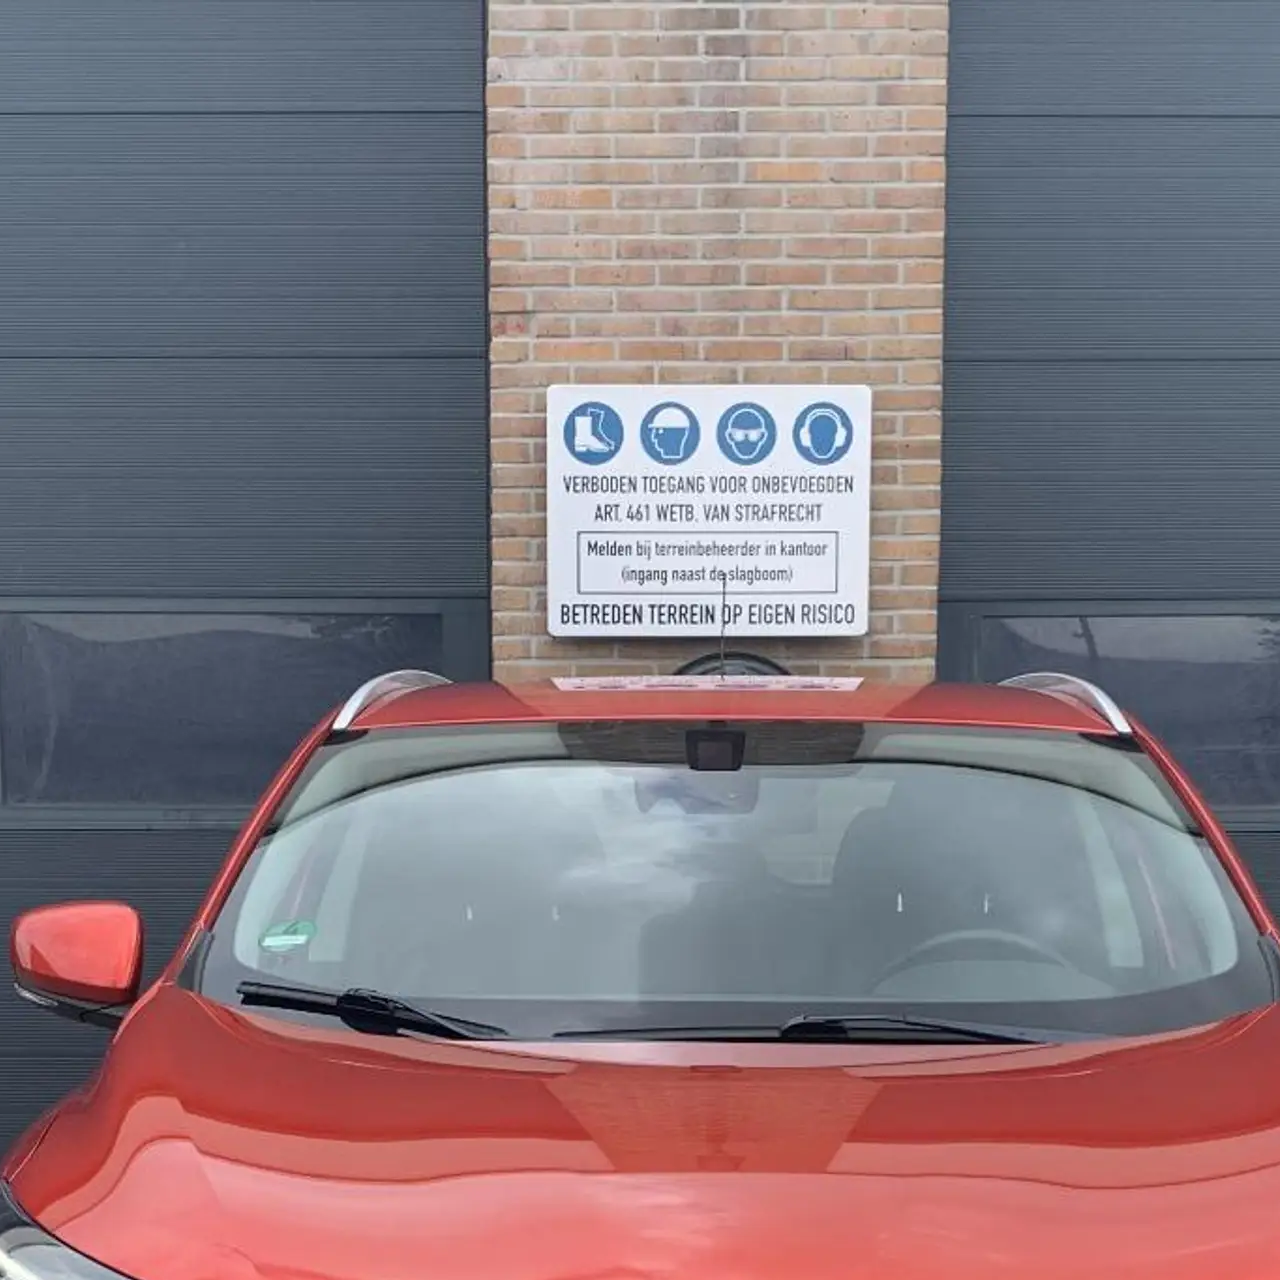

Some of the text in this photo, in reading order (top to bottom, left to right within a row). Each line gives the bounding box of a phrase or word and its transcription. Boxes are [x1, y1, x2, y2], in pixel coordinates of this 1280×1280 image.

[563, 475, 854, 493] VERBODEN TOEGANG VOOR ONBEVOEGDEN
[594, 504, 823, 522] ART. 461 WETB. VAN STRAFRECHT
[587, 540, 828, 561] Melden bij terreinbeheerder in kantoor
[621, 564, 793, 586] (ingang naast de slagboom)
[561, 604, 856, 625] BETREDEN TERREIN OP EIGEN RISICO
